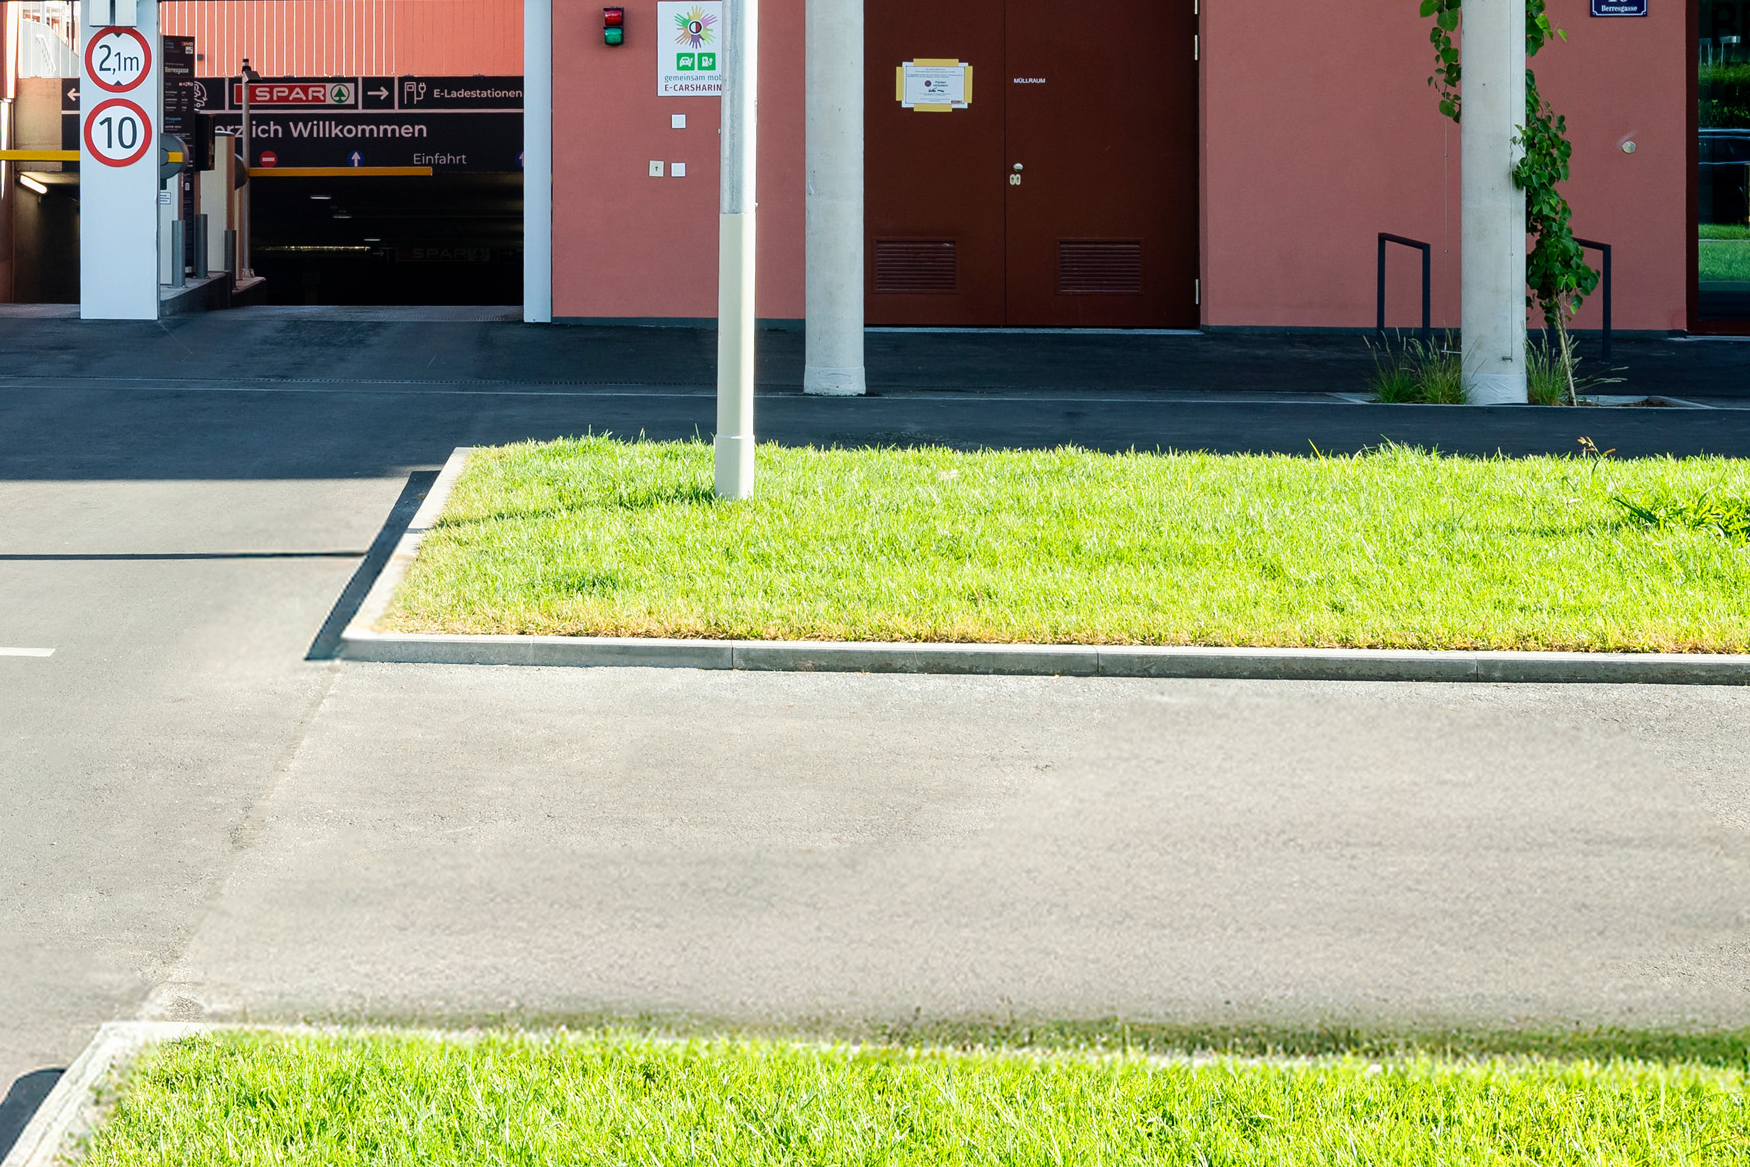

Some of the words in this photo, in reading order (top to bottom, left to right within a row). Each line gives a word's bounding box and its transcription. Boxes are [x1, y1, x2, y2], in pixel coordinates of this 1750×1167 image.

[1601, 4, 1638, 13] Berresgasse
[98, 44, 140, 75] 2,1m
[664, 74, 706, 83] gemeinsam
[255, 86, 325, 101] SPAR
[433, 88, 523, 99] E-Ladestationen
[664, 84, 722, 92] E-CARSHARIN
[99, 116, 138, 150] 10
[289, 120, 428, 138] Willkommen
[413, 152, 468, 165] Einfahrt
